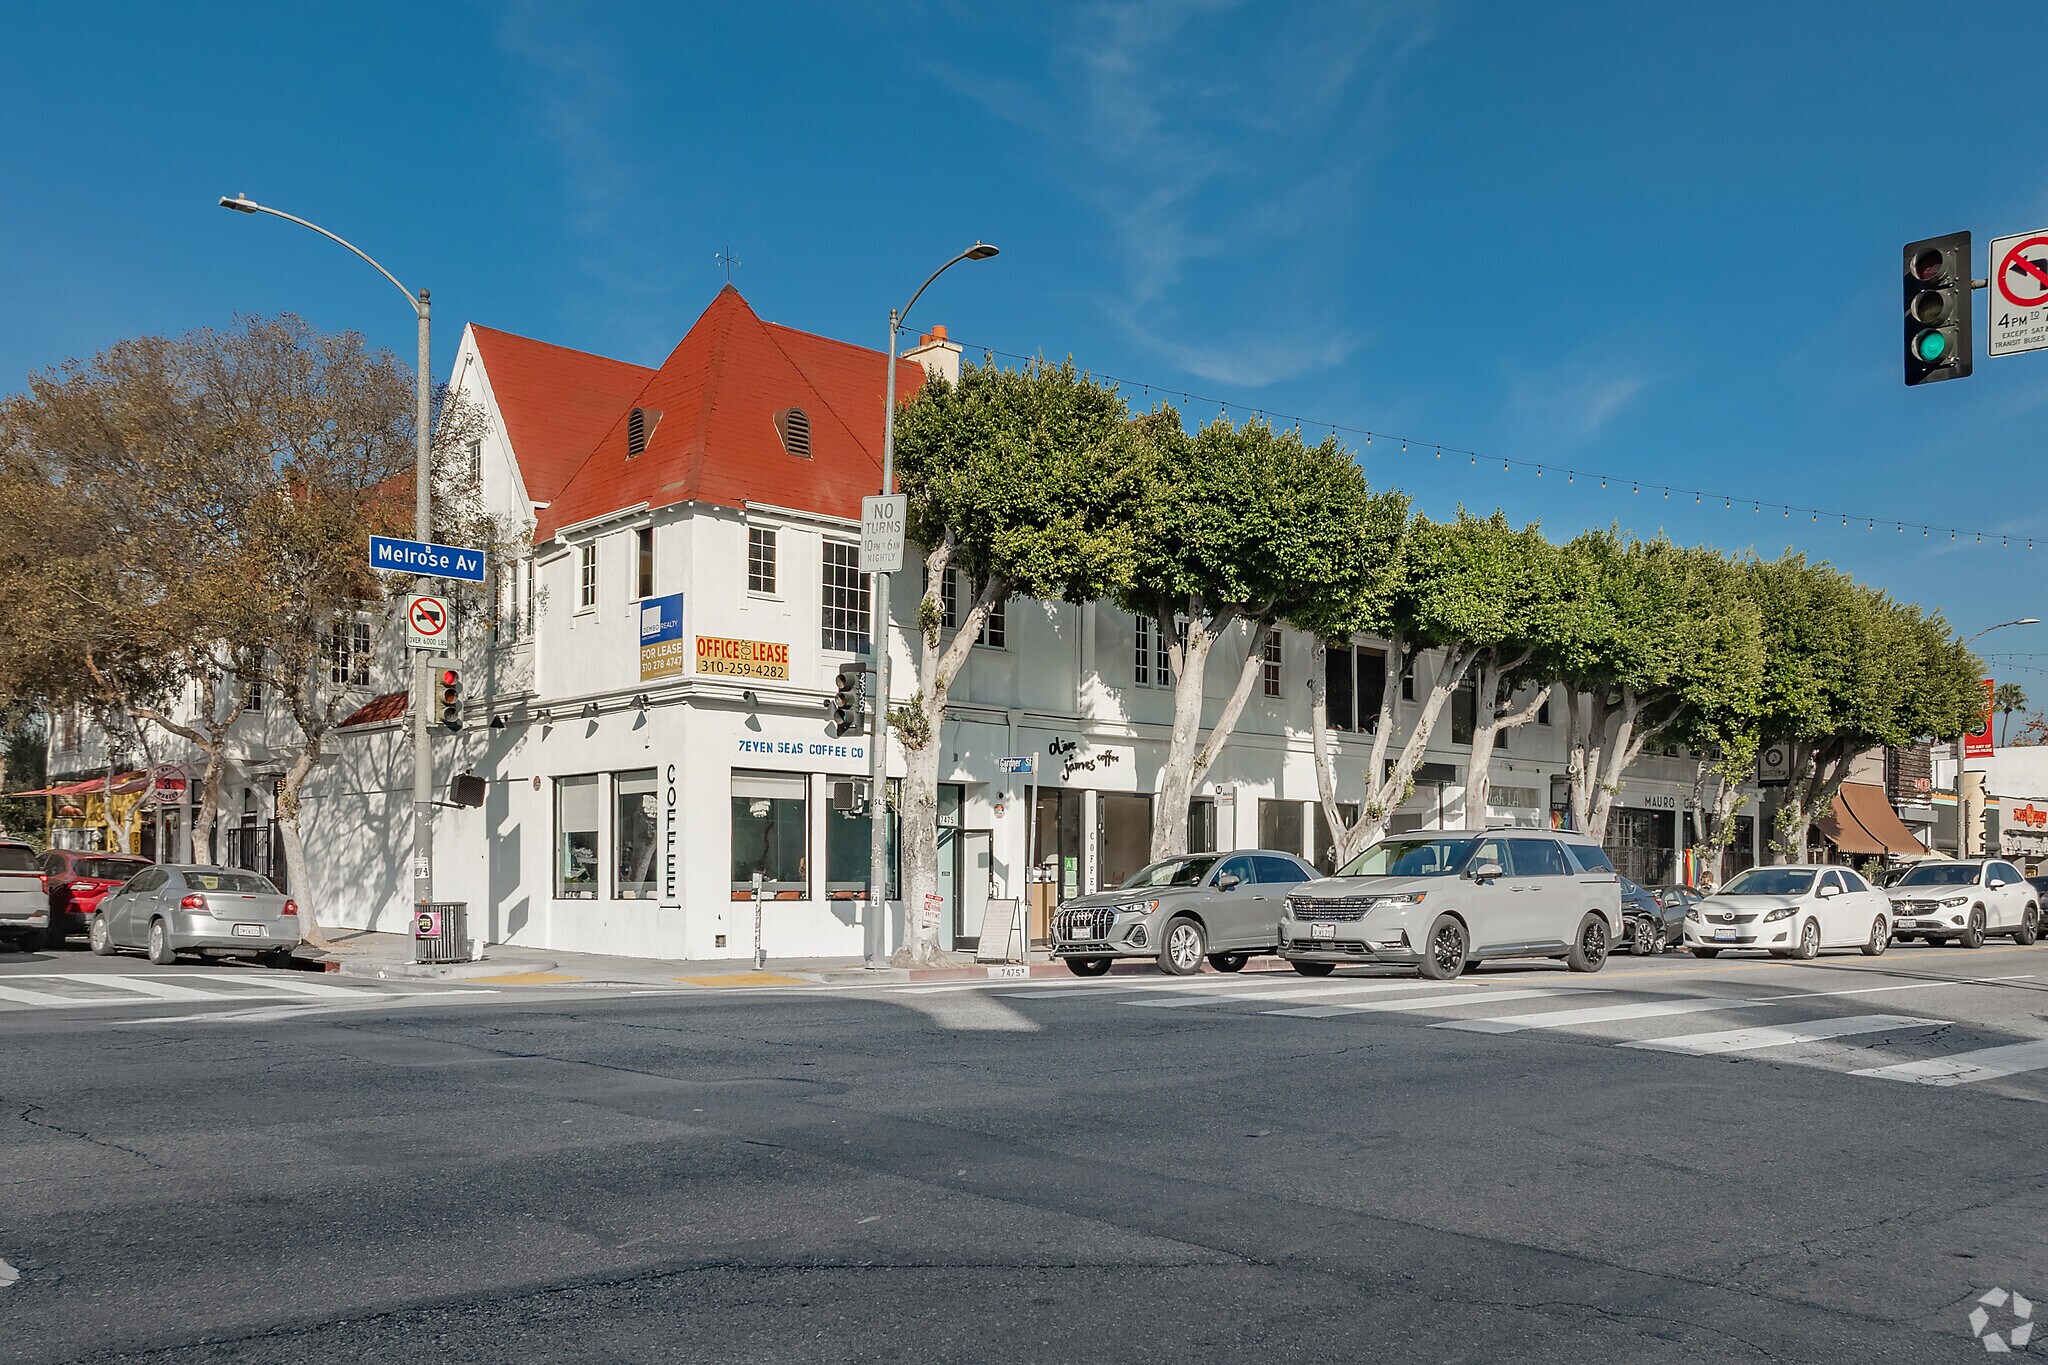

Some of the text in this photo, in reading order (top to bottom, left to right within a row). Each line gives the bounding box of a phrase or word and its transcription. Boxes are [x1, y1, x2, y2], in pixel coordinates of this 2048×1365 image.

[2030, 311, 2040, 319] TO
[2002, 329, 2028, 338] EXCEPT
[2031, 326, 2044, 334] SAT
[1995, 335, 2045, 348] TRANSIT BUSES
[874, 503, 893, 519] NO
[866, 521, 900, 534] TURNS
[378, 544, 477, 571] Melrose Av
[868, 553, 896, 562] NIGHTLY
[643, 620, 678, 633] DEMBO REALTY
[642, 642, 682, 660] FOR LEASE
[697, 638, 739, 659] OFFICE
[740, 641, 751, 660] FOR
[752, 643, 787, 663] LEASE
[642, 662, 651, 672] 310
[653, 660, 664, 670] 278
[666, 656, 682, 667] 4747
[702, 660, 784, 678] 310-259-4282
[739, 740, 863, 758] 7EVEN SEAS COFFEE CO
[1049, 736, 1076, 755] olive
[1062, 750, 1119, 780] james coffee
[1645, 796, 1675, 808] MAURO
[940, 816, 954, 824] 7475
[667, 763, 676, 898] COFFEE
[1066, 860, 1071, 869] A
[1001, 969, 1020, 977] 7475
